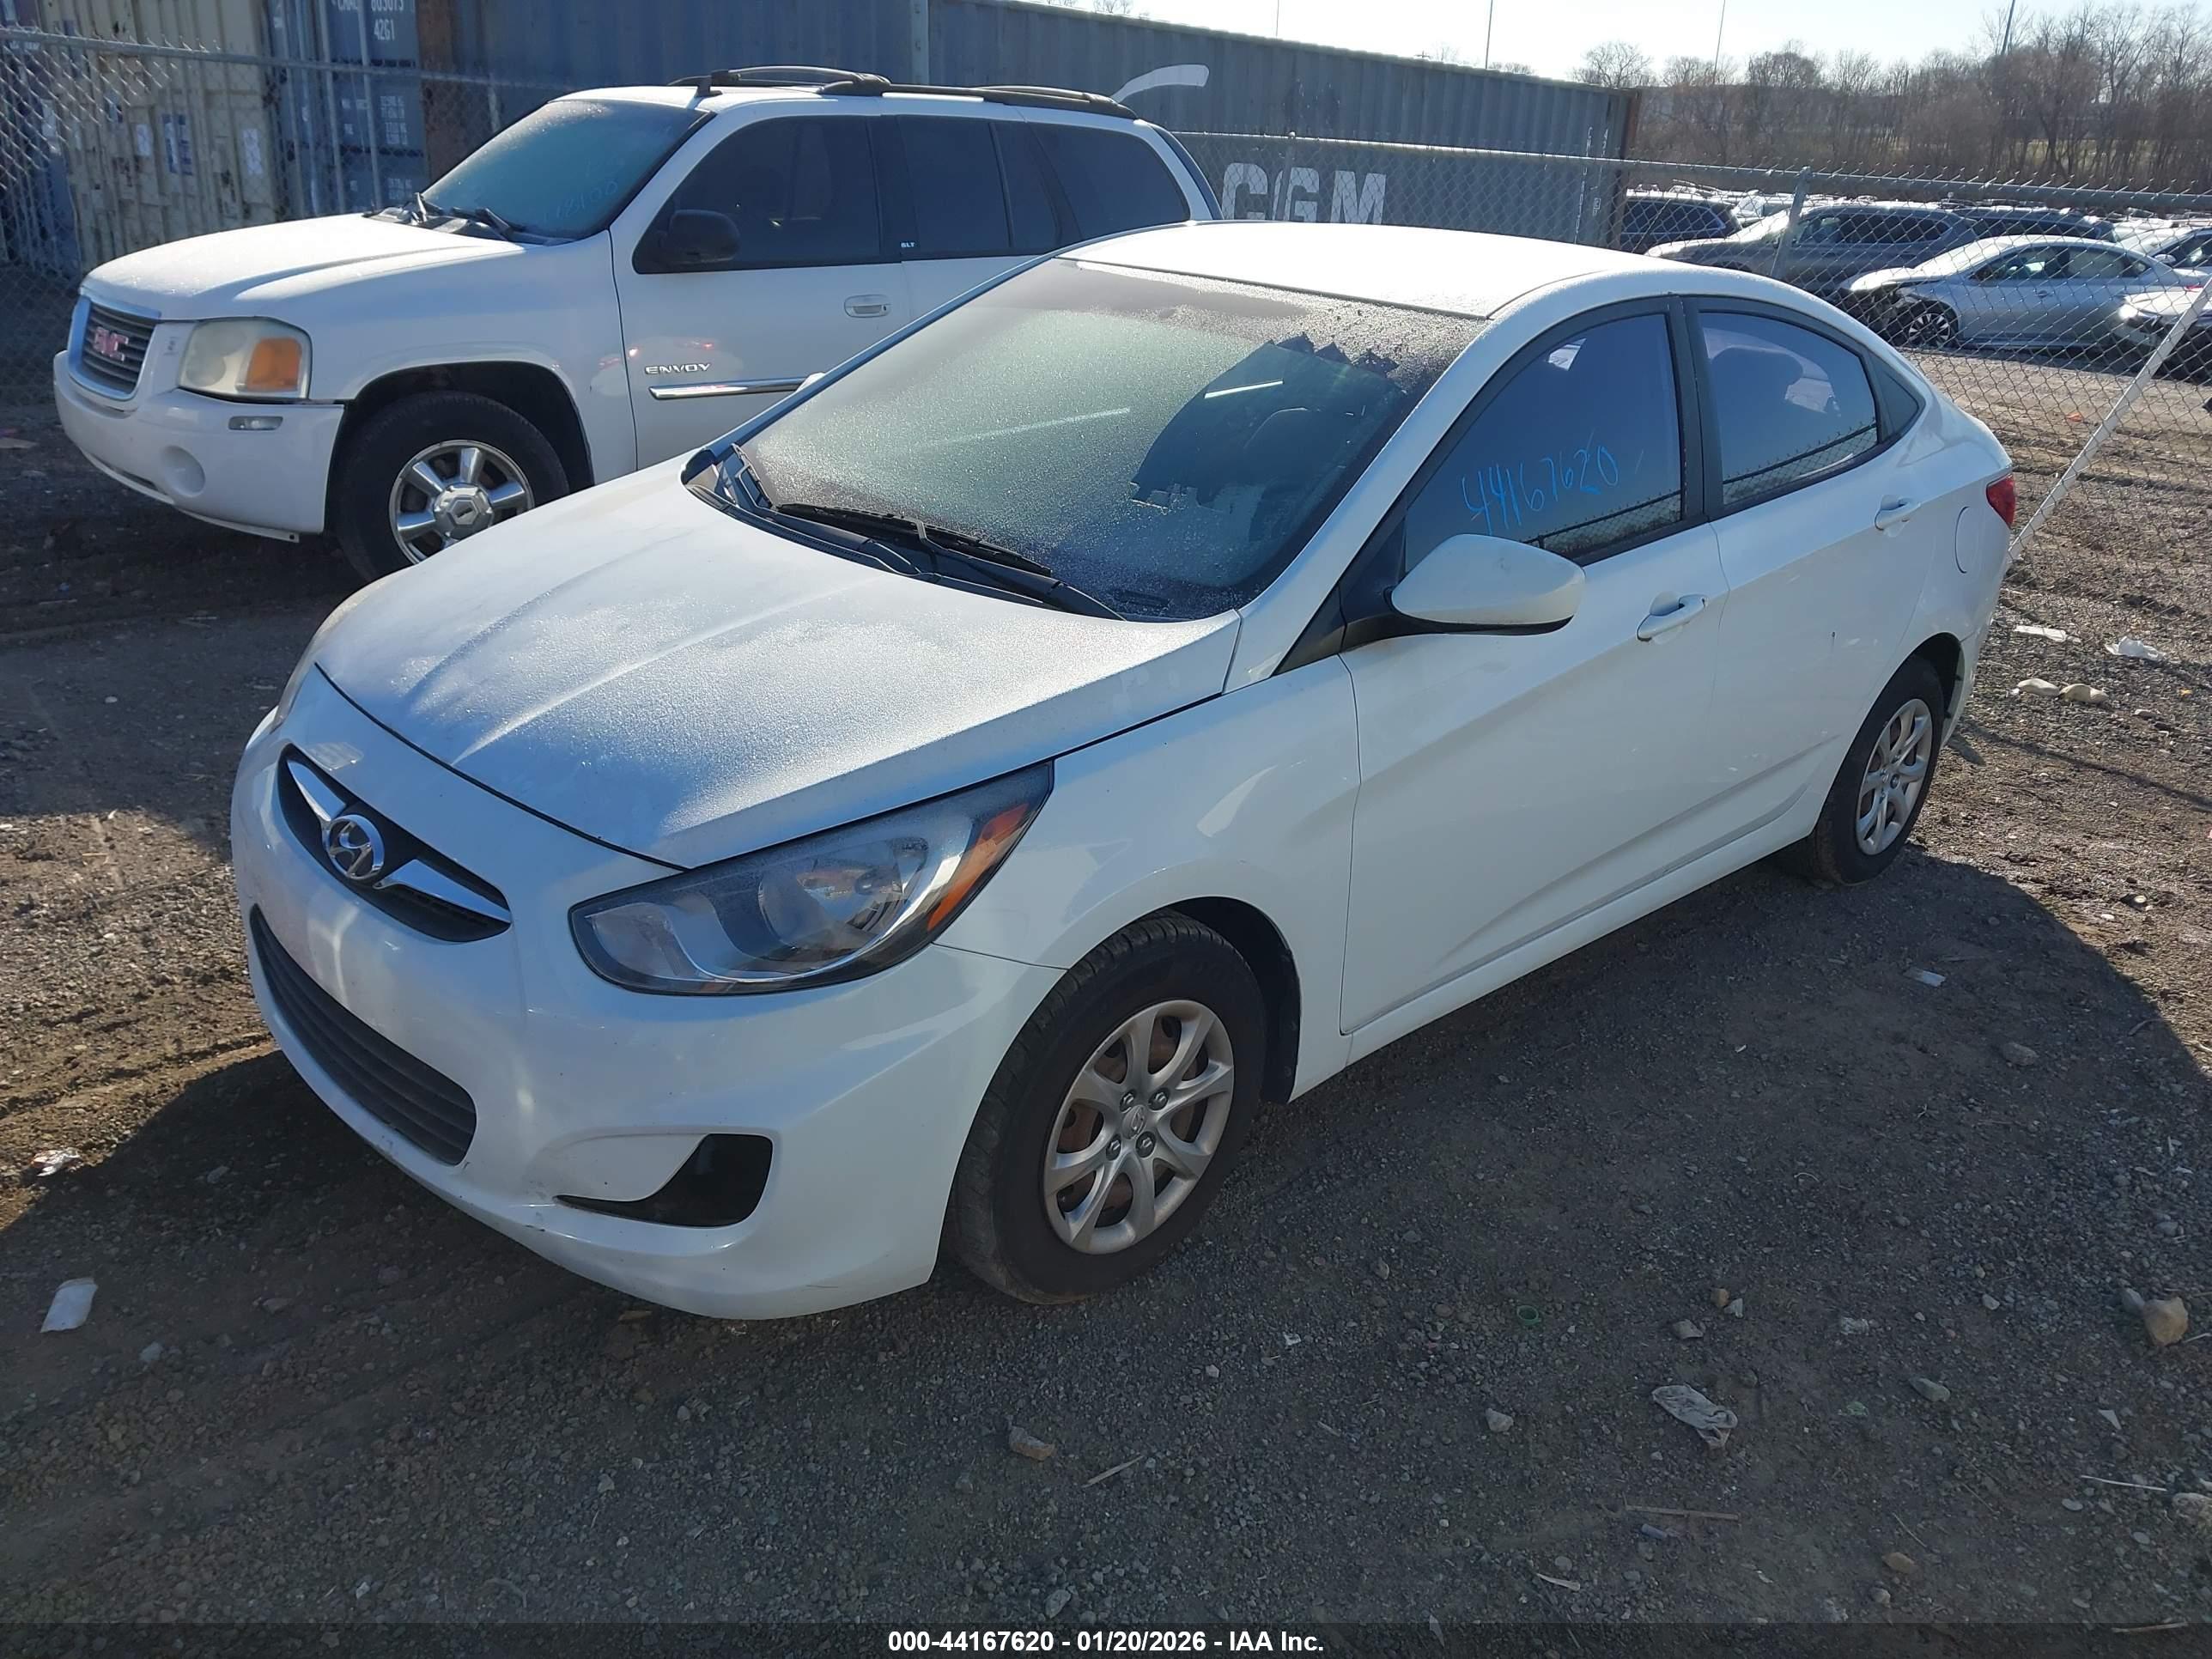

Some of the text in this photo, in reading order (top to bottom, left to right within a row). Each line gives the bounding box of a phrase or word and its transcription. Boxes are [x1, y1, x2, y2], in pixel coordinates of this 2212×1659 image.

[1222, 162, 1387, 225] CGM
[645, 363, 711, 374] ENVOY
[1462, 445, 1620, 536] 44167620
